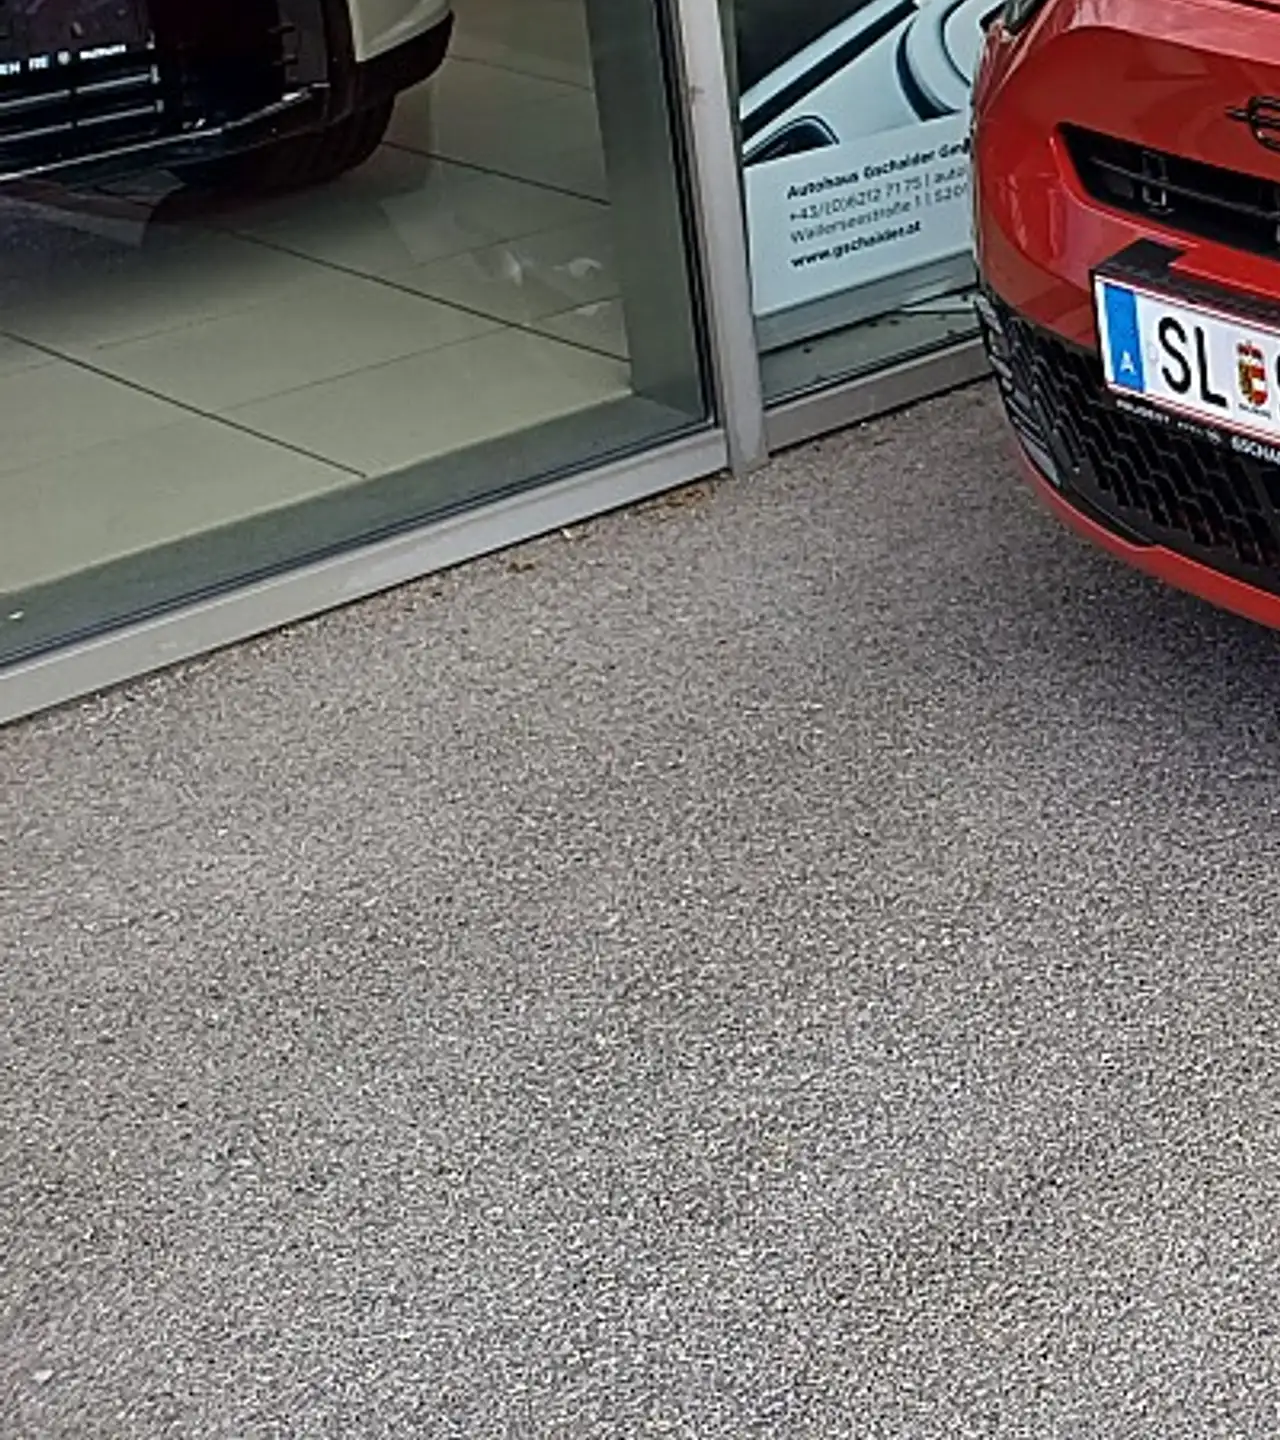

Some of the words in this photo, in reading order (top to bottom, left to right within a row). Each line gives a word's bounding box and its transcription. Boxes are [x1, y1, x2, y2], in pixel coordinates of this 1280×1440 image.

[787, 171, 859, 201] Autohaus
[864, 150, 936, 180] Gschaider
[1119, 351, 1136, 374] A
[1157, 315, 1229, 409] SL
